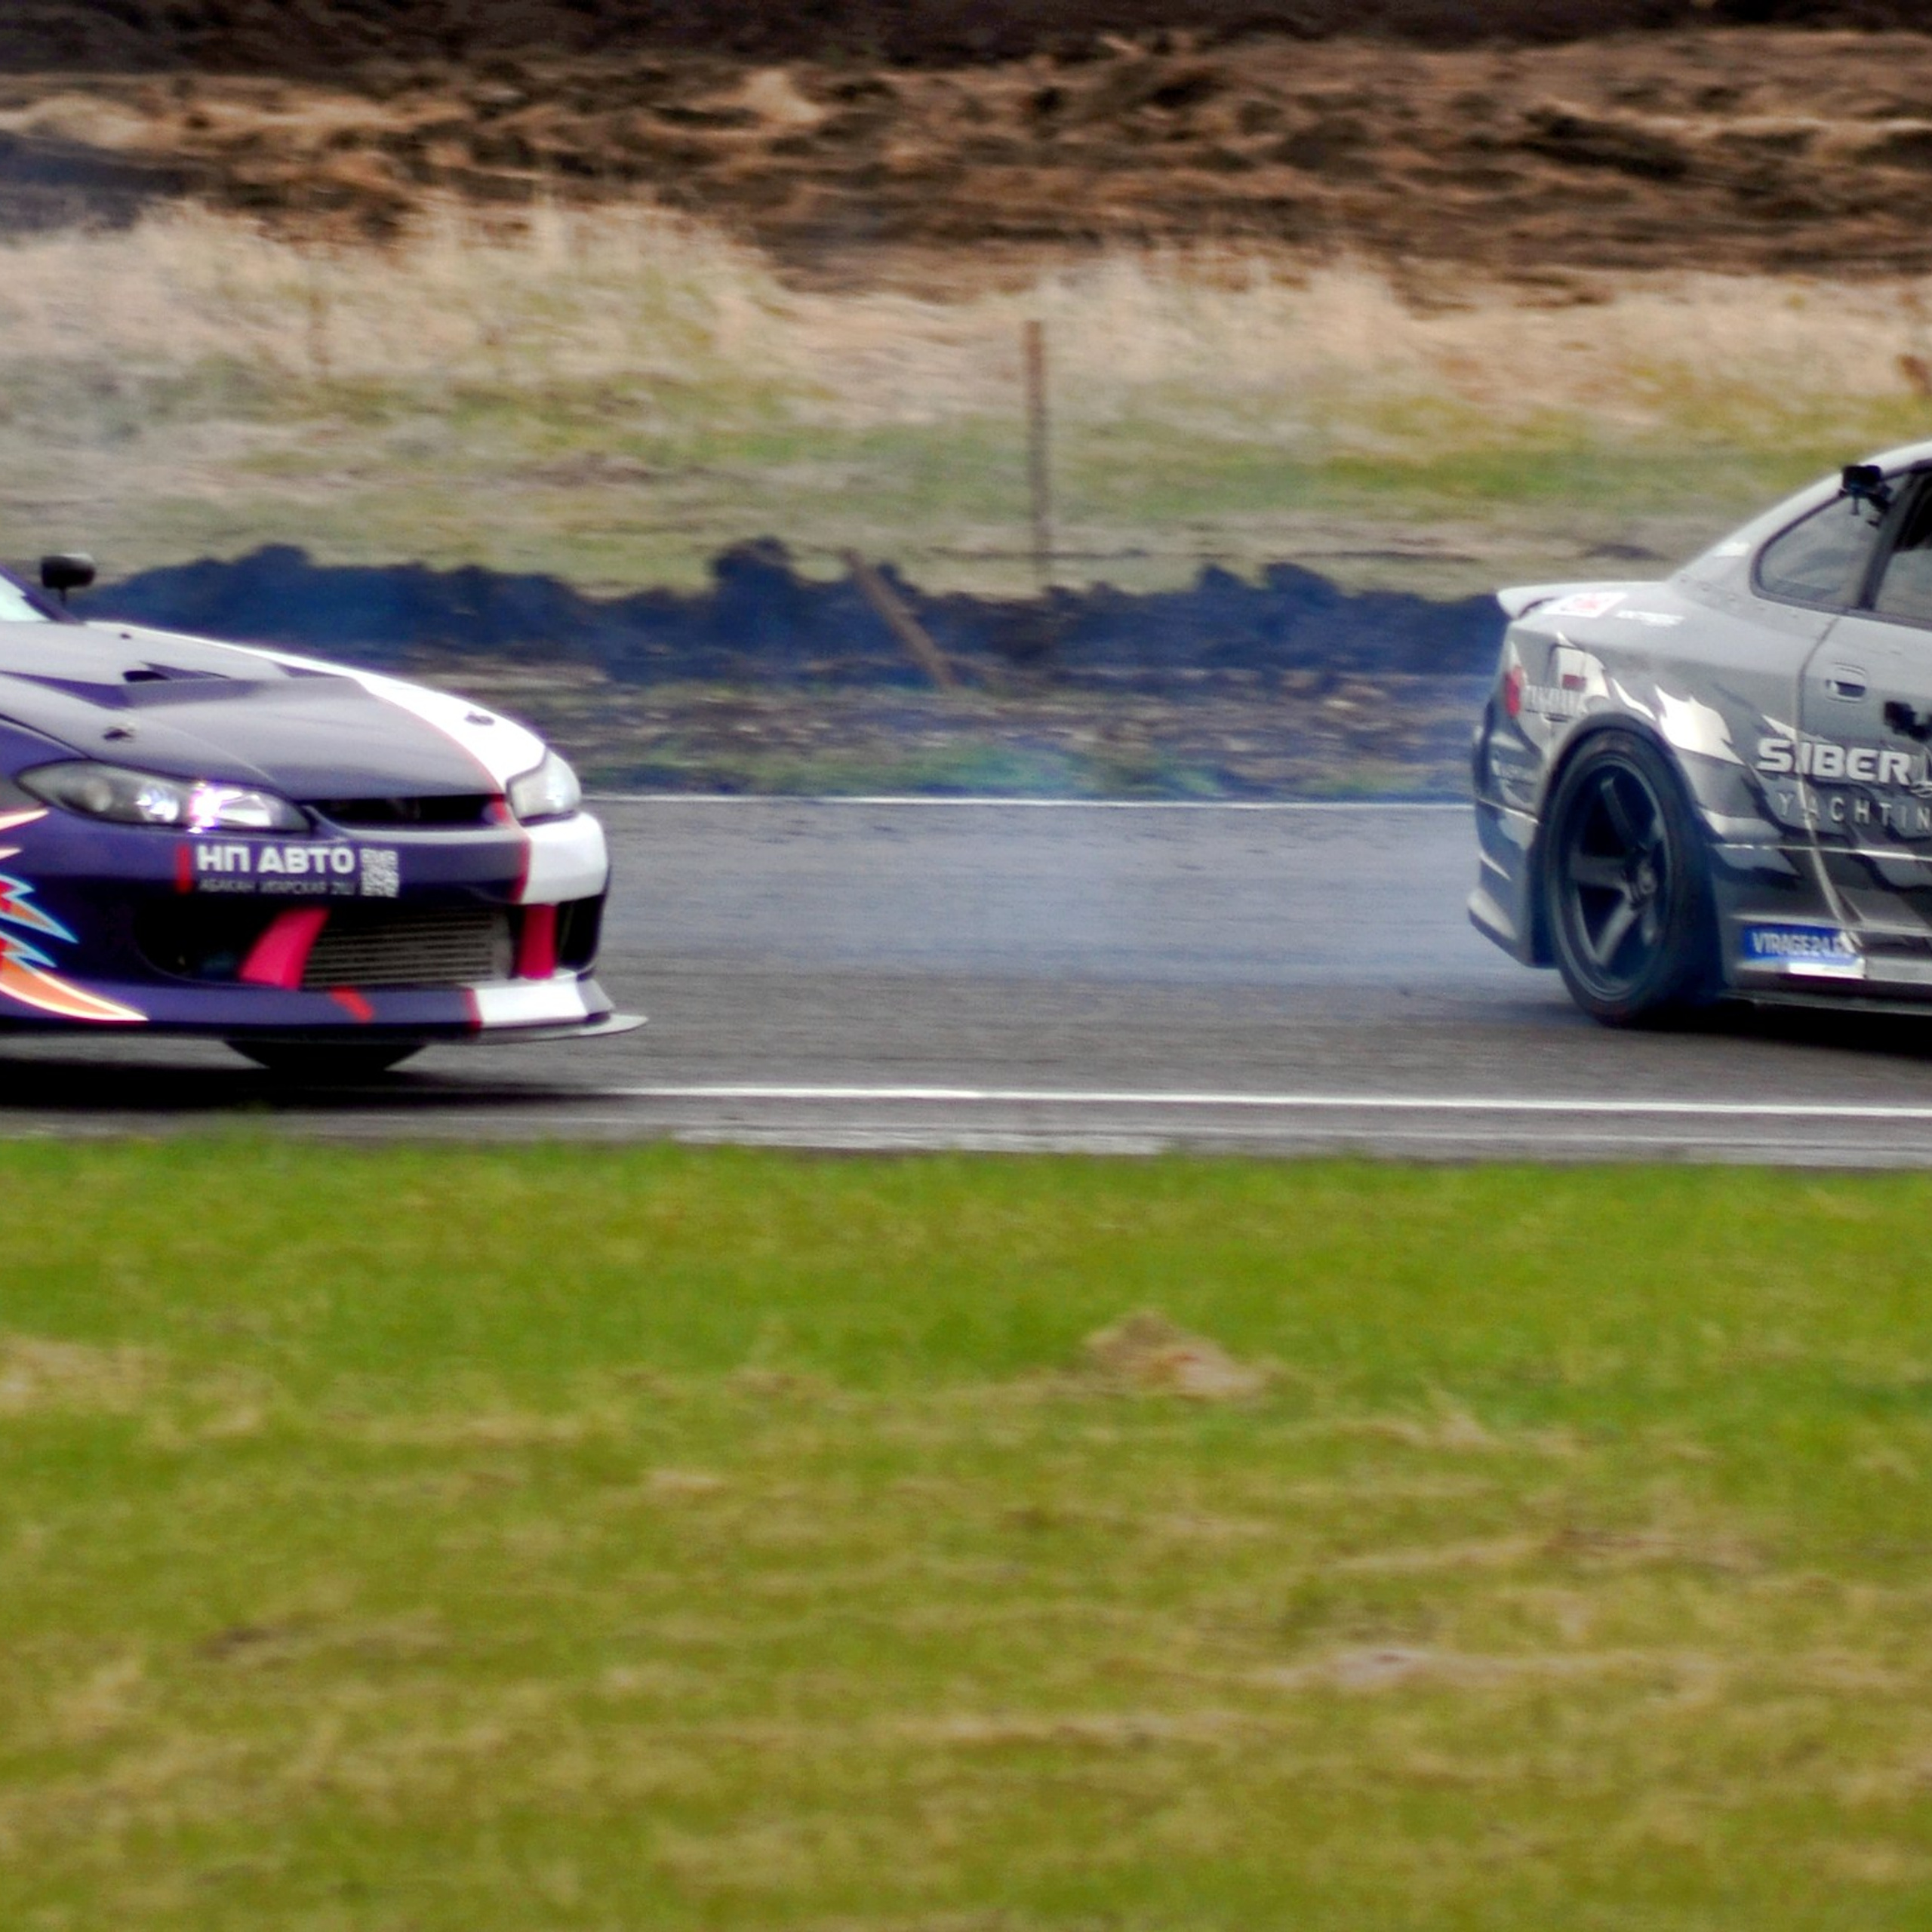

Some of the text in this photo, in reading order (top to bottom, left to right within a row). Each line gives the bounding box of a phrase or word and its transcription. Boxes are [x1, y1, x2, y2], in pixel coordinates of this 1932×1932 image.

[1756, 737, 1912, 786] SIBER
[197, 844, 355, 874] НП АВТО
